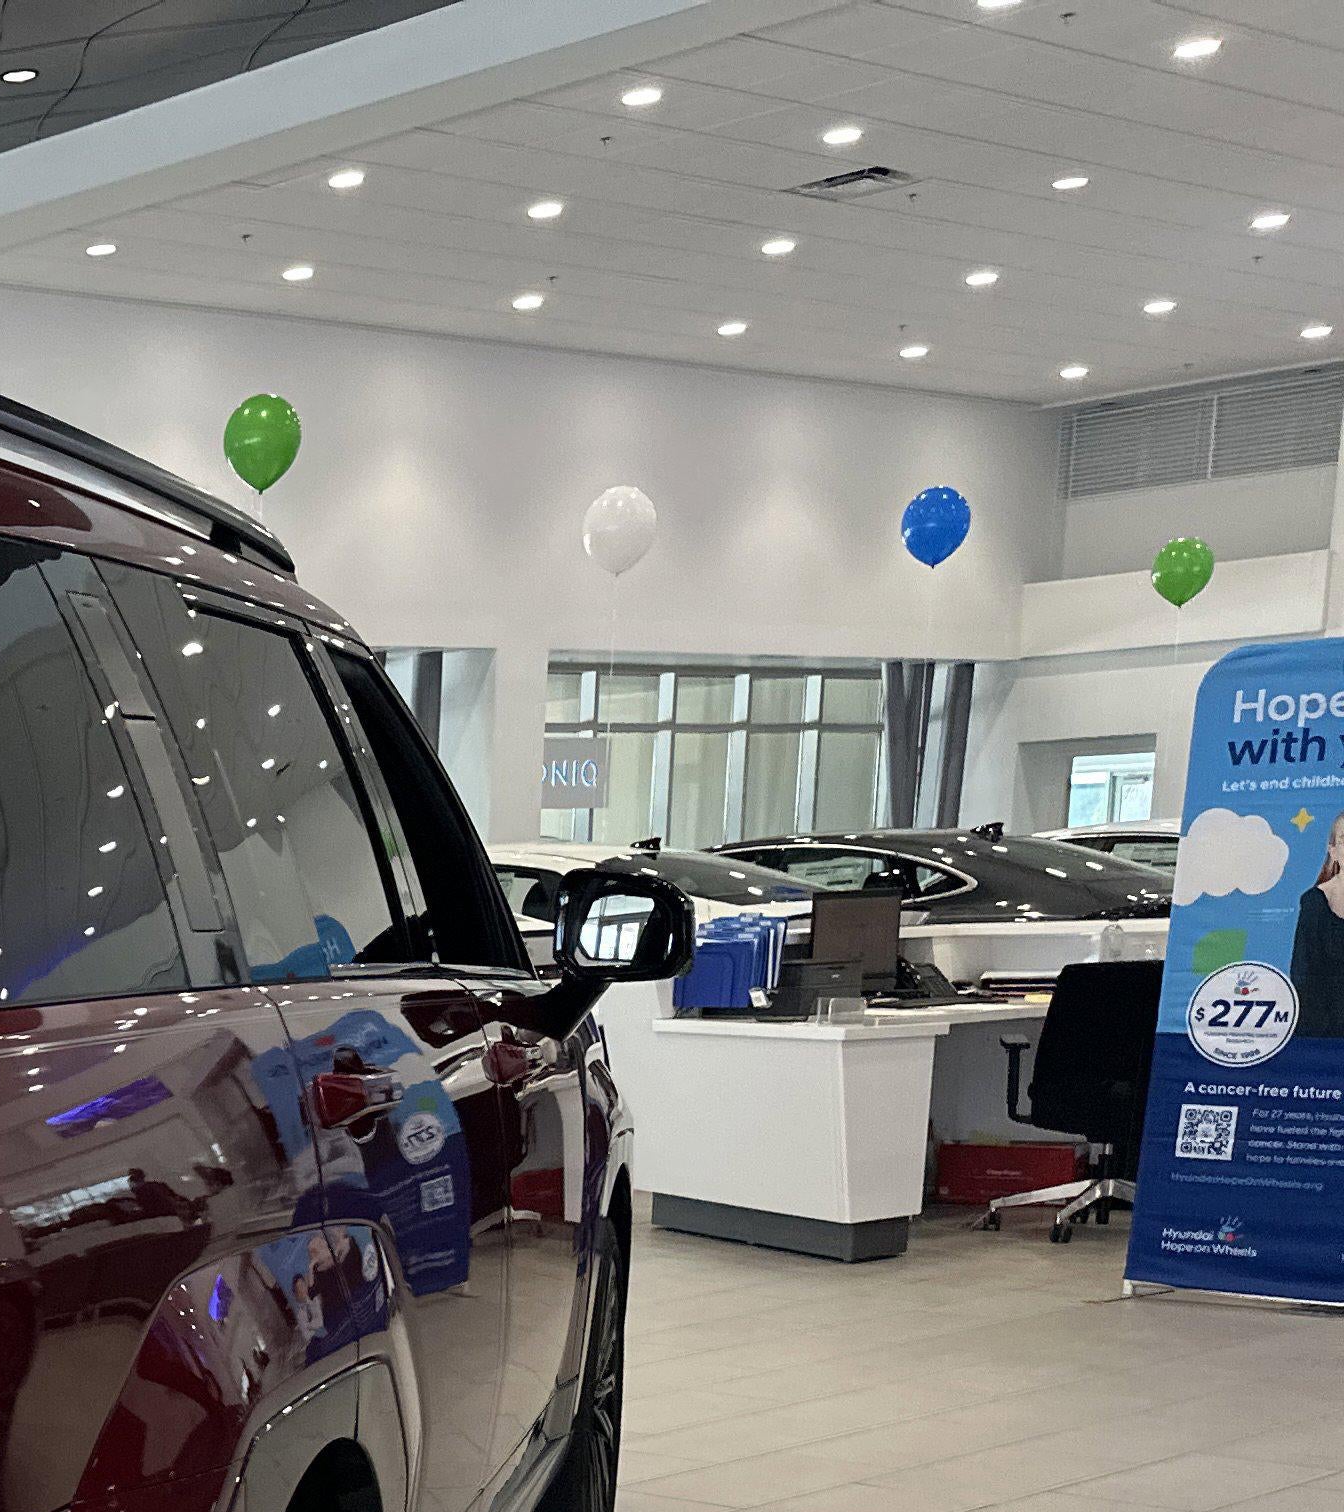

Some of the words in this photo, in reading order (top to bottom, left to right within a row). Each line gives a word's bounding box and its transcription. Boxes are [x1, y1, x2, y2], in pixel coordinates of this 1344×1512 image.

[1228, 727, 1326, 766] with
[541, 759, 598, 787] NIQ
[1222, 780, 1257, 792] Let's
[1260, 776, 1290, 790] end
[1184, 1081, 1195, 1093] A
[1198, 1083, 1289, 1097] cancer-free
[1293, 1085, 1342, 1100] future
